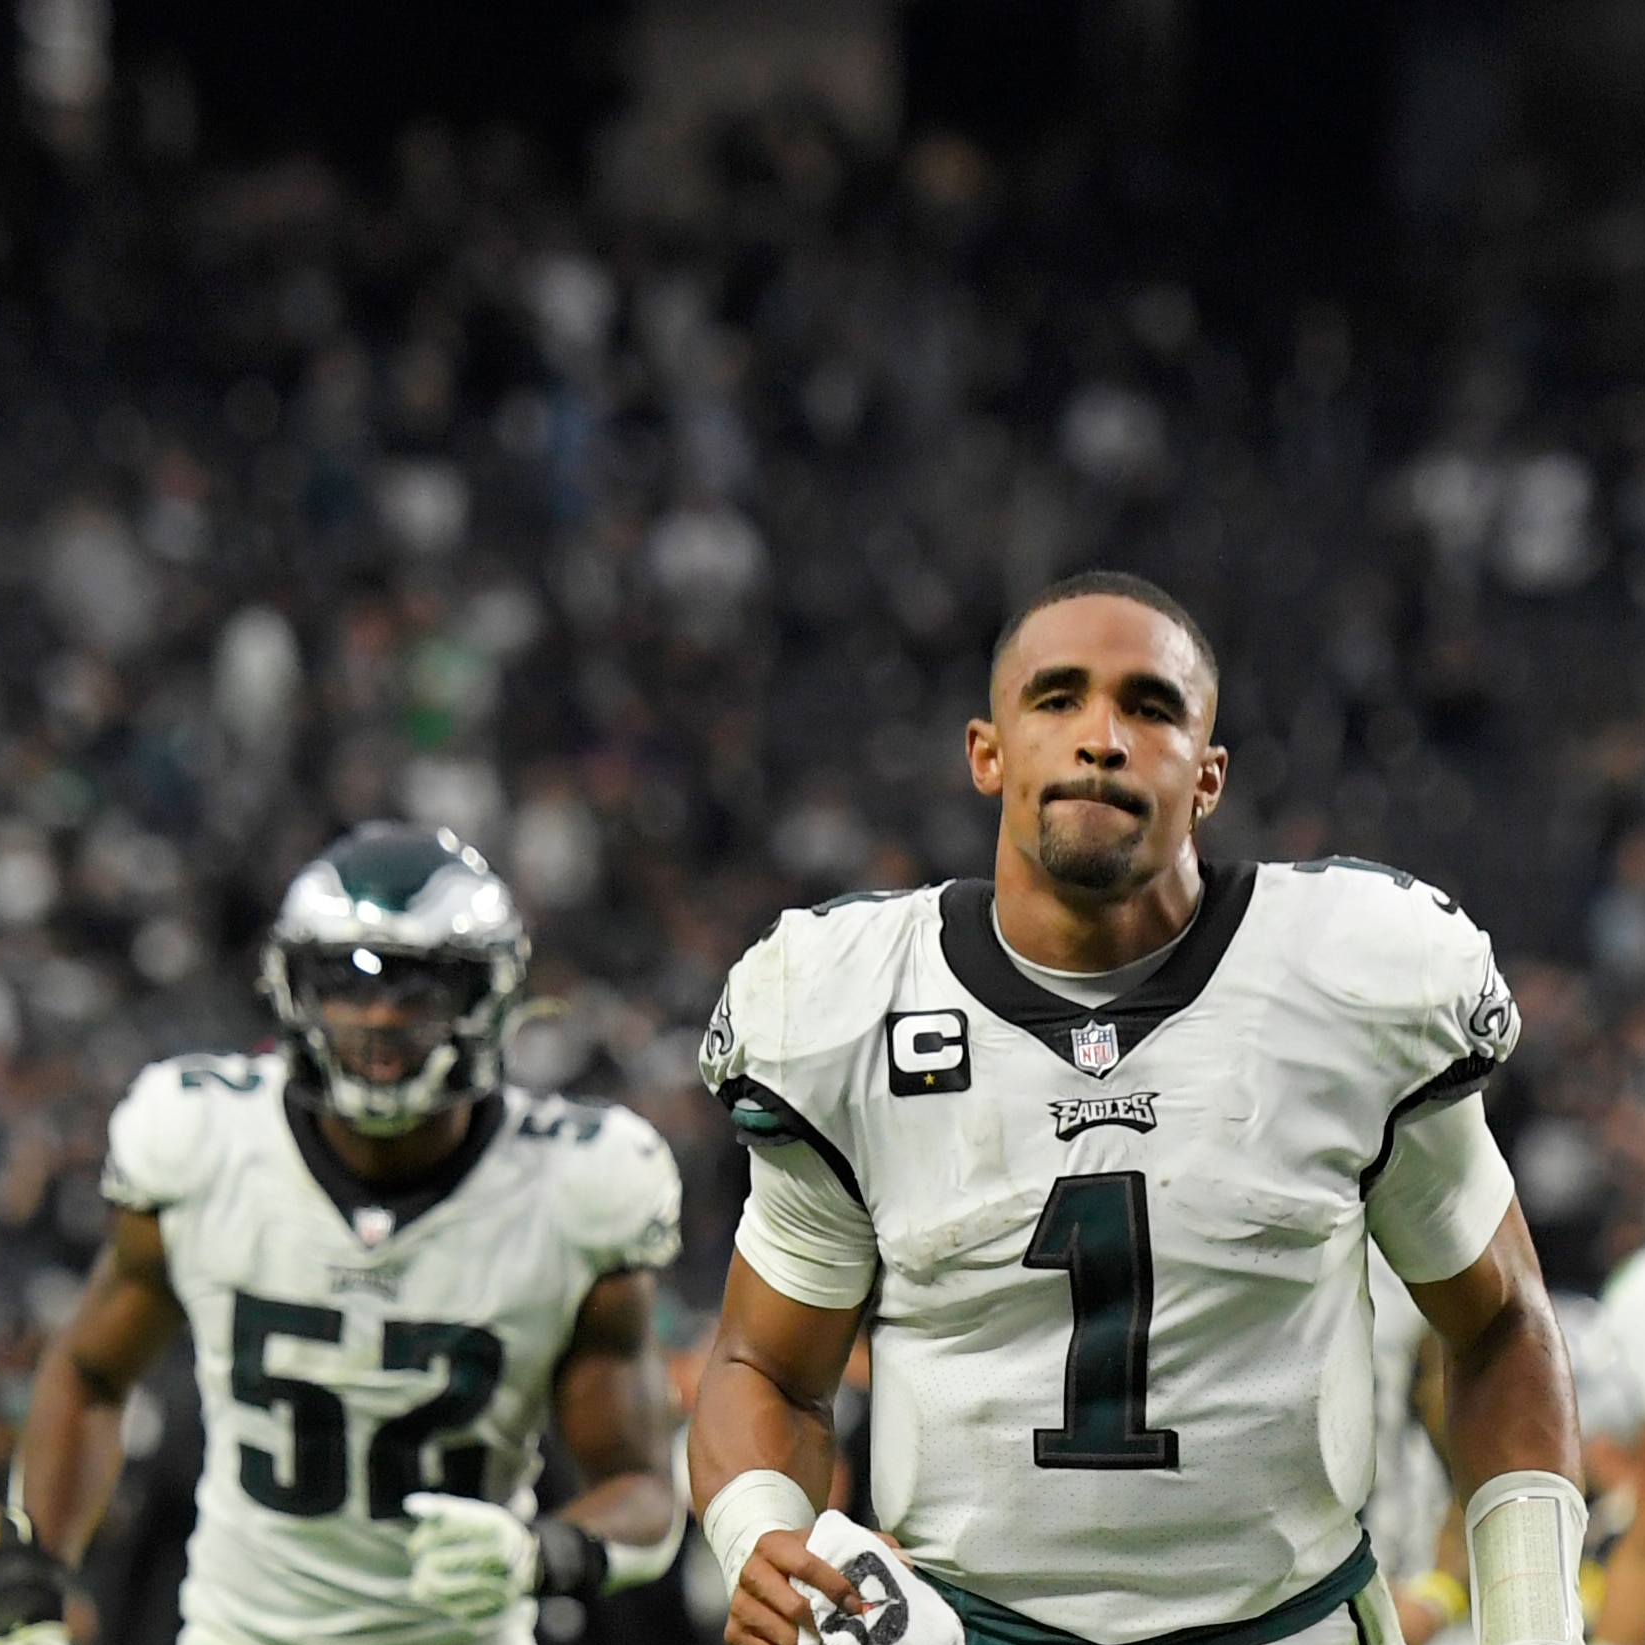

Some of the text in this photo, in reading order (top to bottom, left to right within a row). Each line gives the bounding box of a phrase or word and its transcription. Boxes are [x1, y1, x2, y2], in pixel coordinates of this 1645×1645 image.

[893, 1013, 964, 1073] C
[1081, 1044, 1111, 1063] NFL
[1022, 1170, 1179, 1469] 1
[231, 1291, 503, 1520] 52
